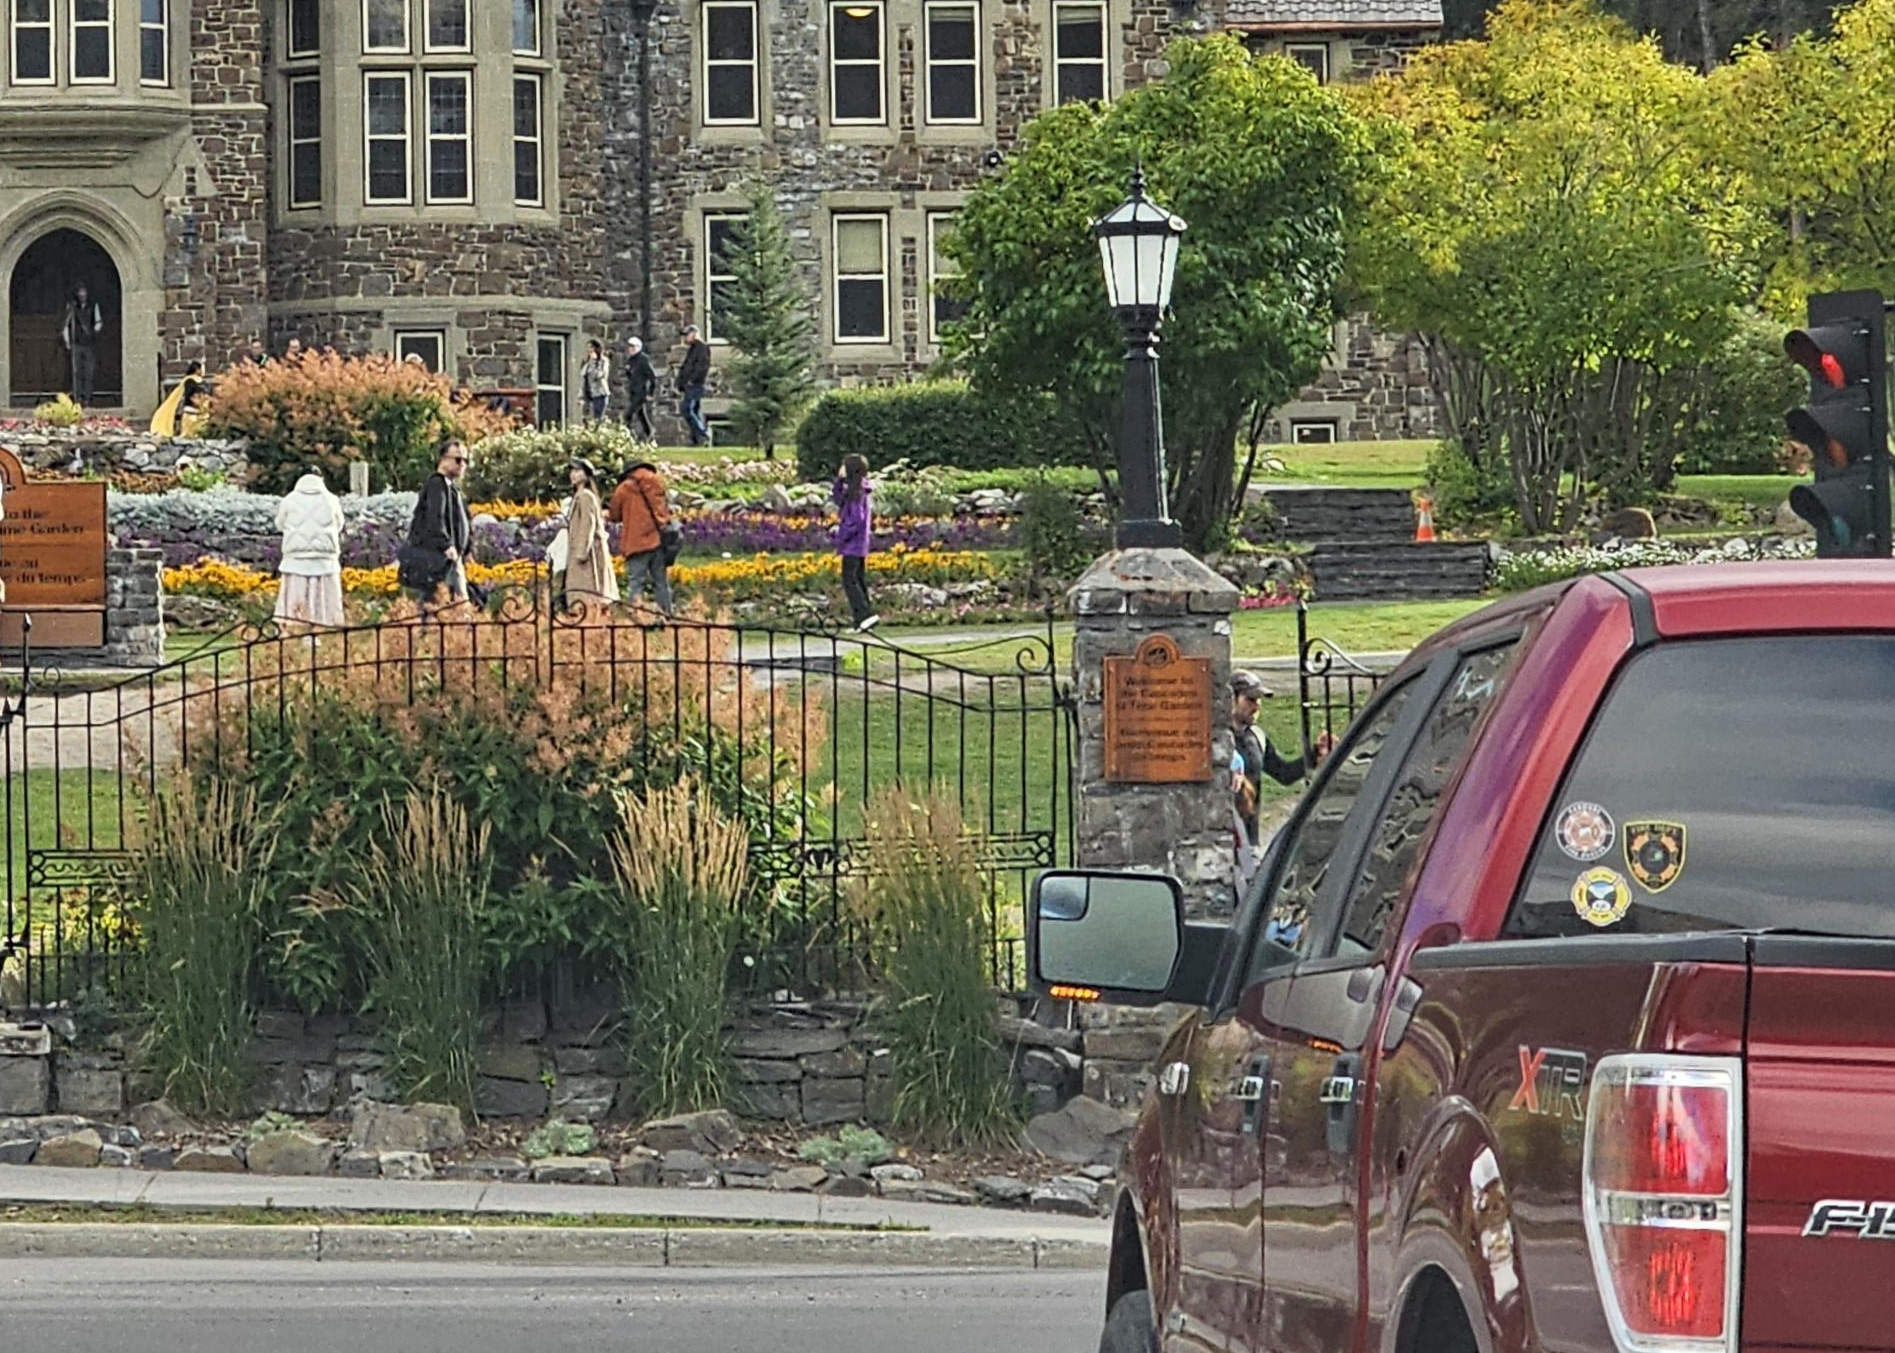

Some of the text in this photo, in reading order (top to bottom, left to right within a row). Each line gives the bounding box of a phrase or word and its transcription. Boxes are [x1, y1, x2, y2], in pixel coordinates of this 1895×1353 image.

[23, 508, 48, 519] the
[31, 523, 84, 535] Garden
[16, 572, 35, 583] du
[1508, 1044, 1587, 1121] XTR
